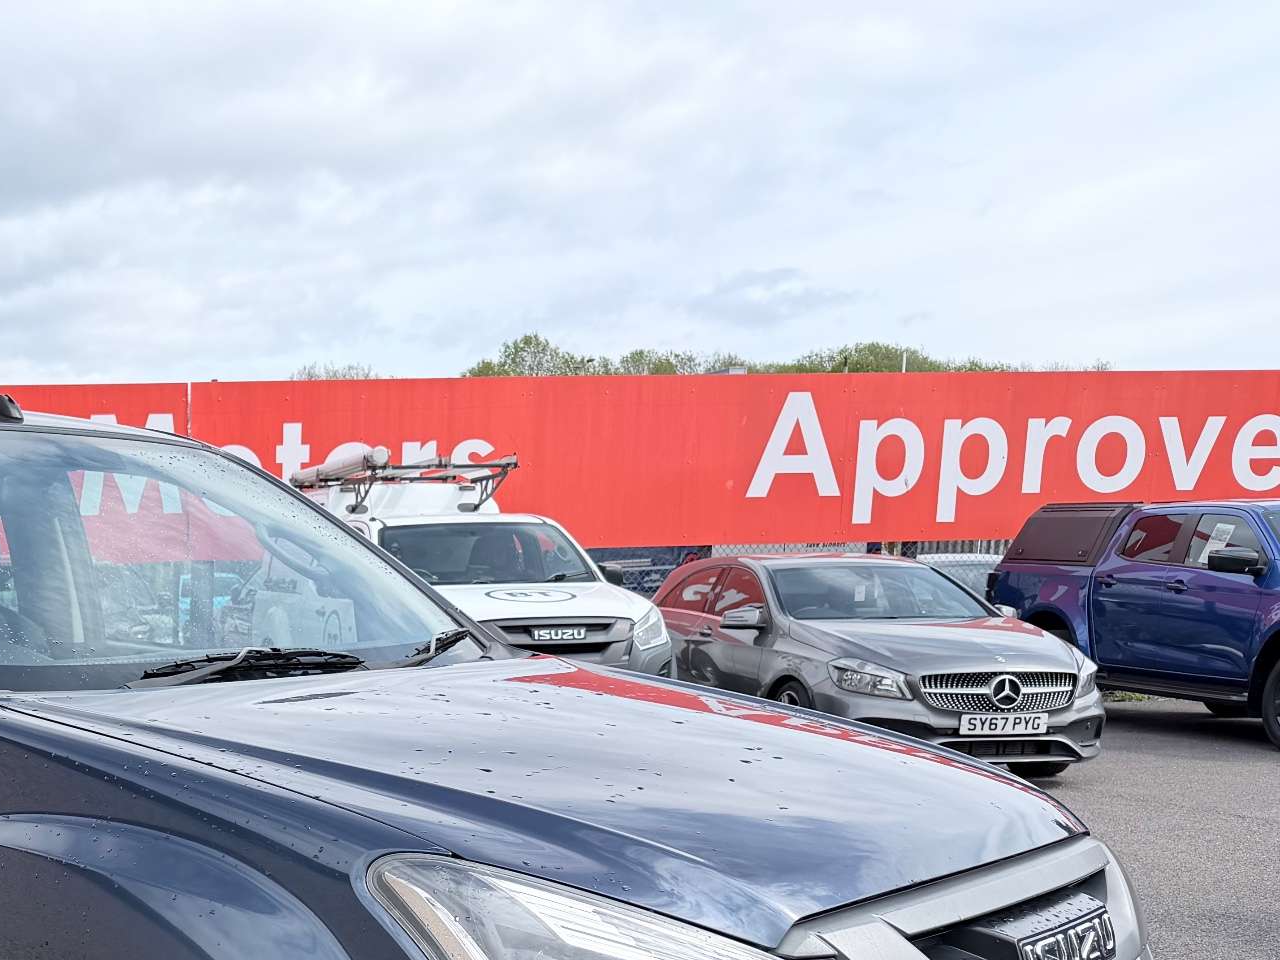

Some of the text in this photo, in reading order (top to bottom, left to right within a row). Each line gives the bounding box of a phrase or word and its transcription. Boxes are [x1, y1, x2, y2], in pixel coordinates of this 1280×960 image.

[745, 391, 1280, 524] Approve
[534, 628, 586, 640] ISUZU
[967, 716, 1042, 731] SY67 PYG
